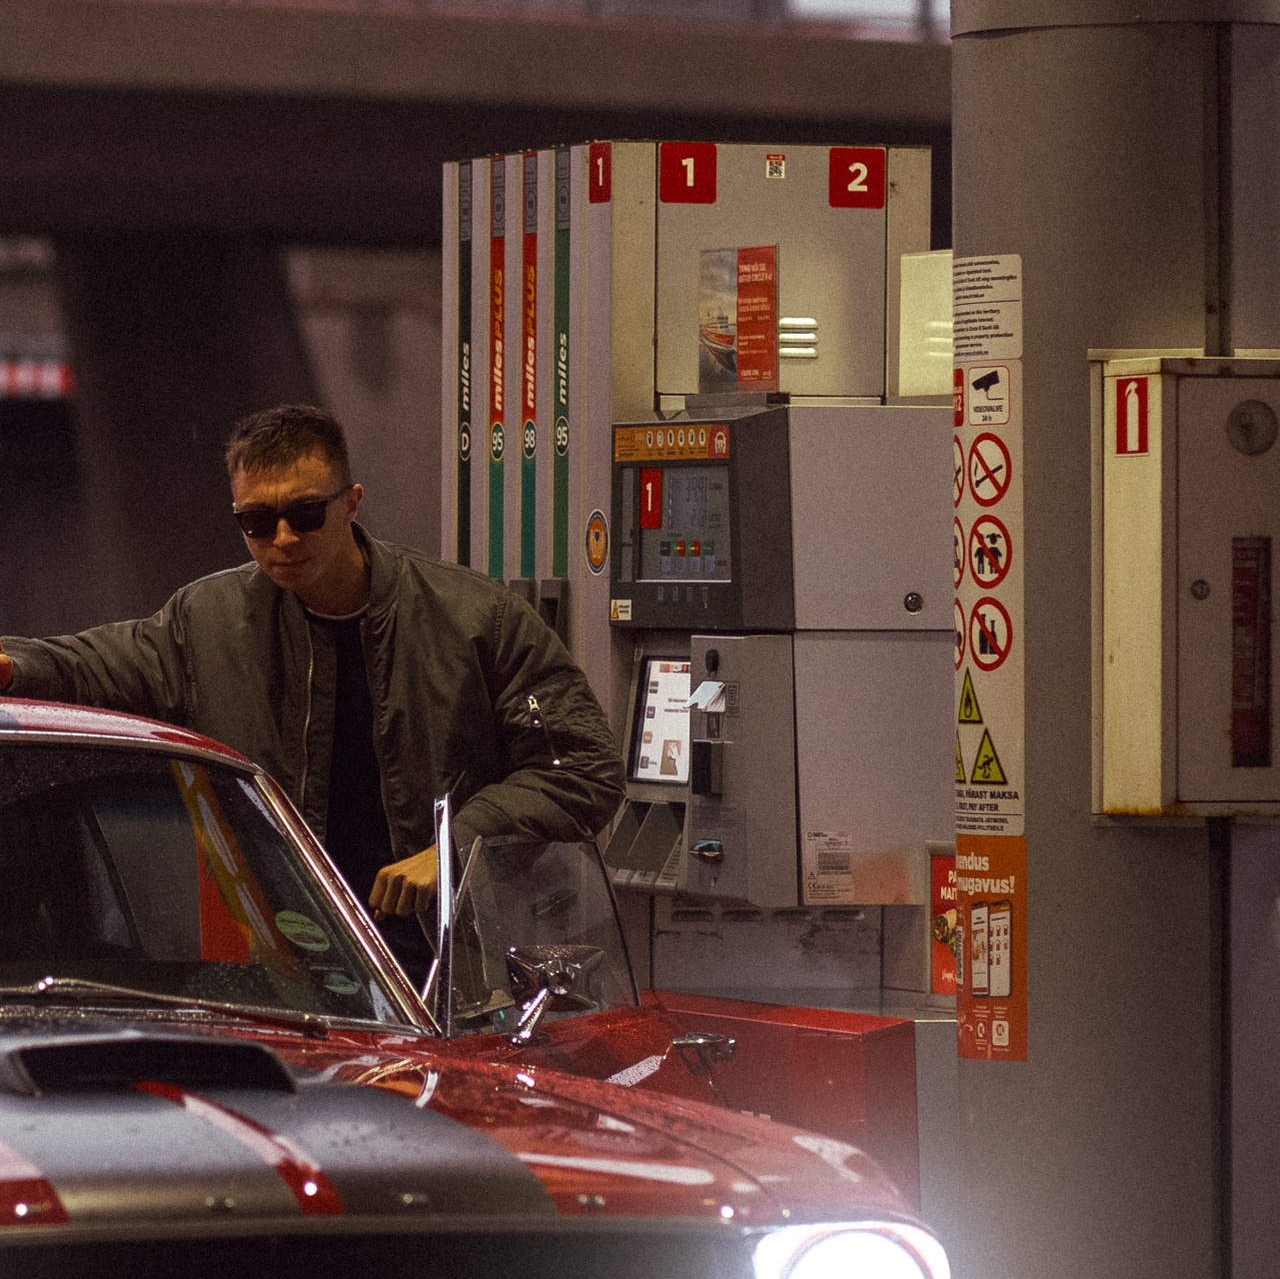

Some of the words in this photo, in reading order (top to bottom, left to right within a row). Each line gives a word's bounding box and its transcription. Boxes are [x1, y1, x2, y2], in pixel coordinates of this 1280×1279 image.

[596, 156, 603, 187] 1
[681, 157, 694, 187] 1
[847, 162, 868, 192] 2
[461, 433, 468, 451] D
[492, 432, 503, 451] 95
[524, 429, 535, 448] 98
[557, 426, 568, 446] 95
[646, 482, 652, 512] 1
[989, 790, 1020, 800] MAKSA
[978, 803, 999, 812] AFTER
